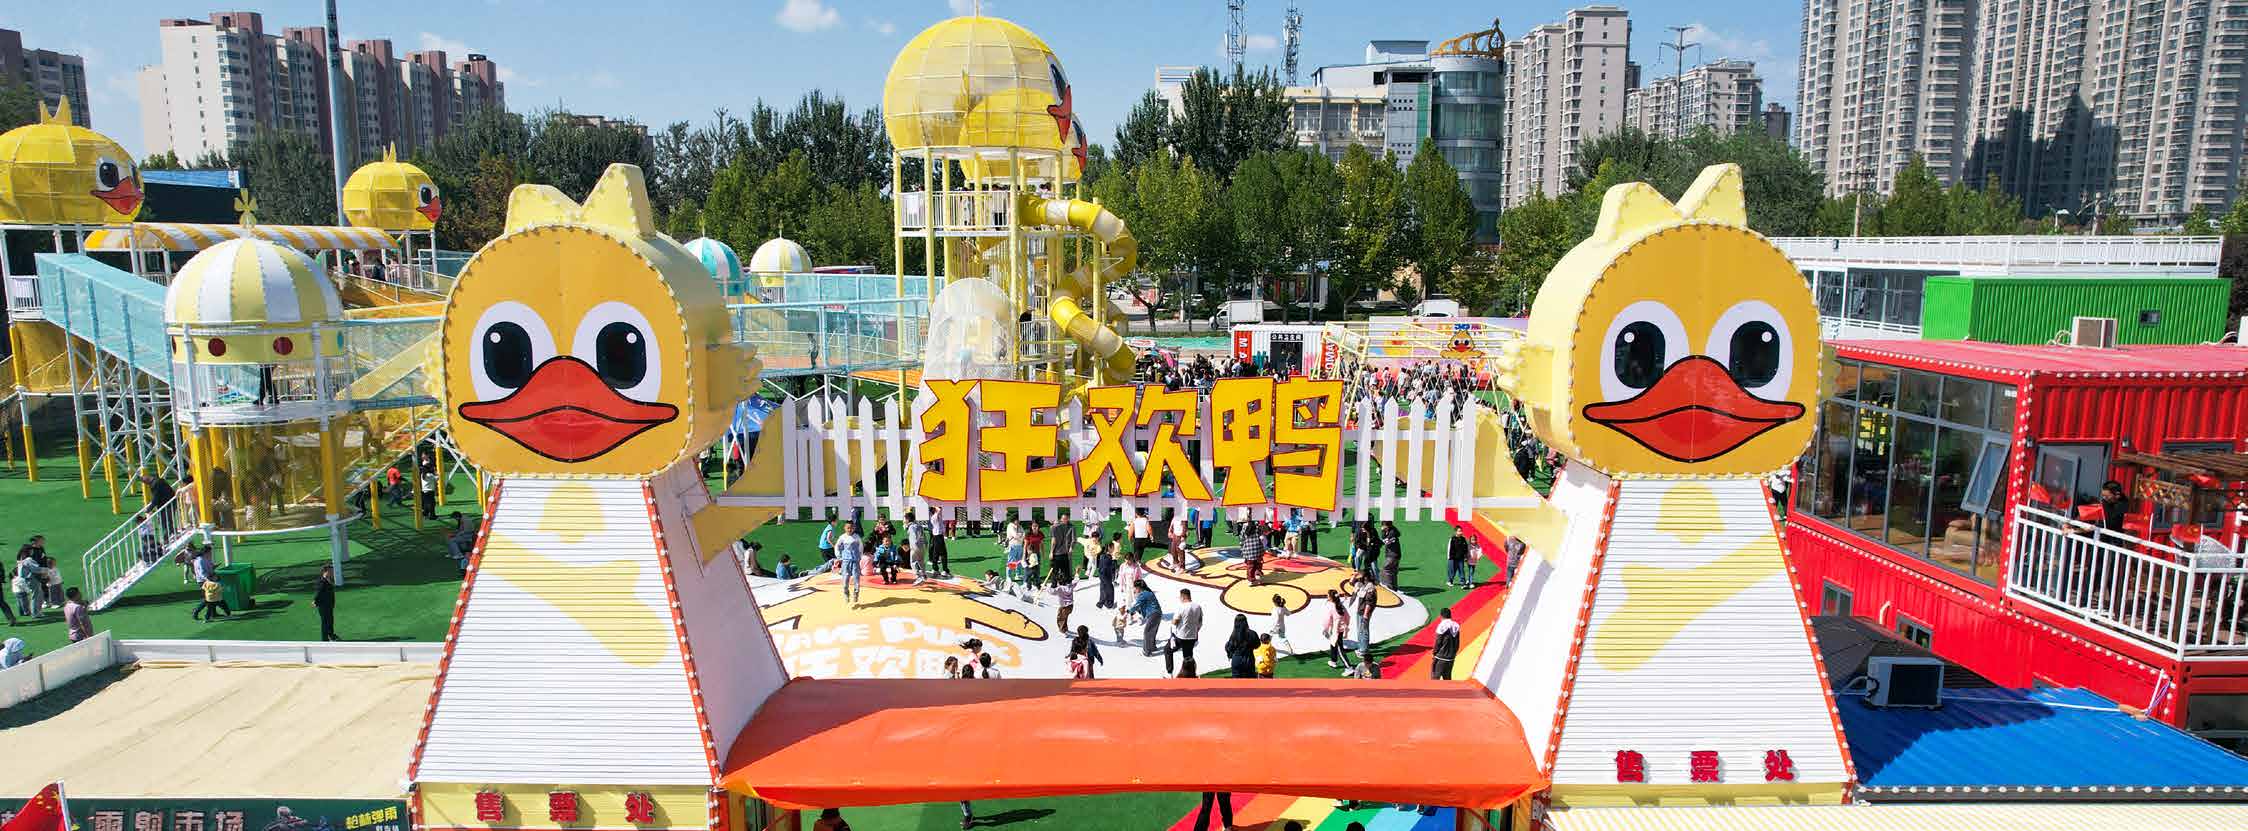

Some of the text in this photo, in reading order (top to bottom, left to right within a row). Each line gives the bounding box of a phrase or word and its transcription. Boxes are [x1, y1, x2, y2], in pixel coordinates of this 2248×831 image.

[918, 376, 1343, 511] 狂欢鸭
[1616, 749, 1794, 782] 售票处
[475, 791, 655, 823] 售票处
